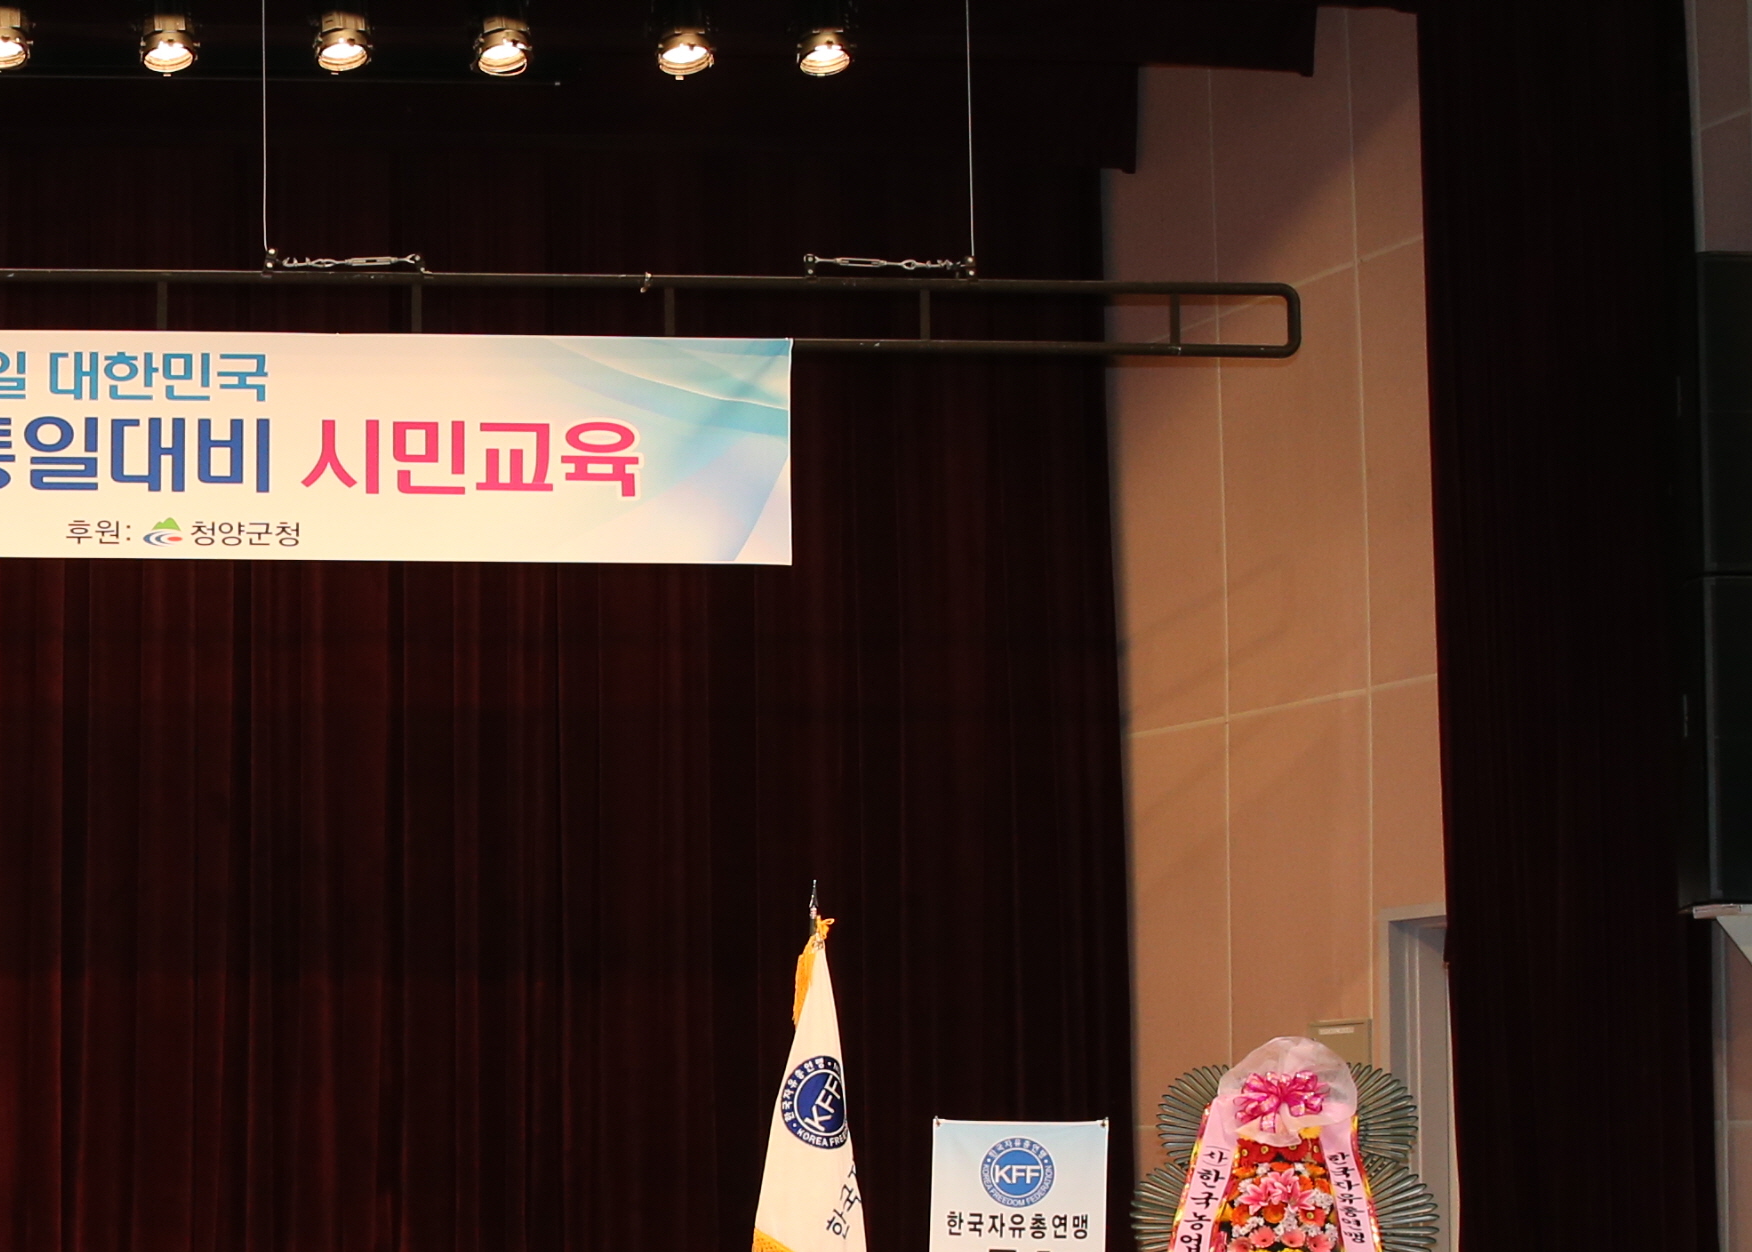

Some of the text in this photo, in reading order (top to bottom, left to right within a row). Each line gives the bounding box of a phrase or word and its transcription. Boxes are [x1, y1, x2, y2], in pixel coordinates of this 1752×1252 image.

[49, 351, 269, 402] 대한민국
[300, 418, 640, 498] 시민교육
[190, 520, 300, 547] 청양군청
[804, 1074, 842, 1132] KFF
[797, 1127, 828, 1147] KOREA
[989, 1187, 1025, 1206] FREEDOM
[1025, 1164, 1053, 1205] FEDERATION
[994, 1164, 1042, 1184] KFF
[946, 1211, 1090, 1240] 한국자유총연맹
